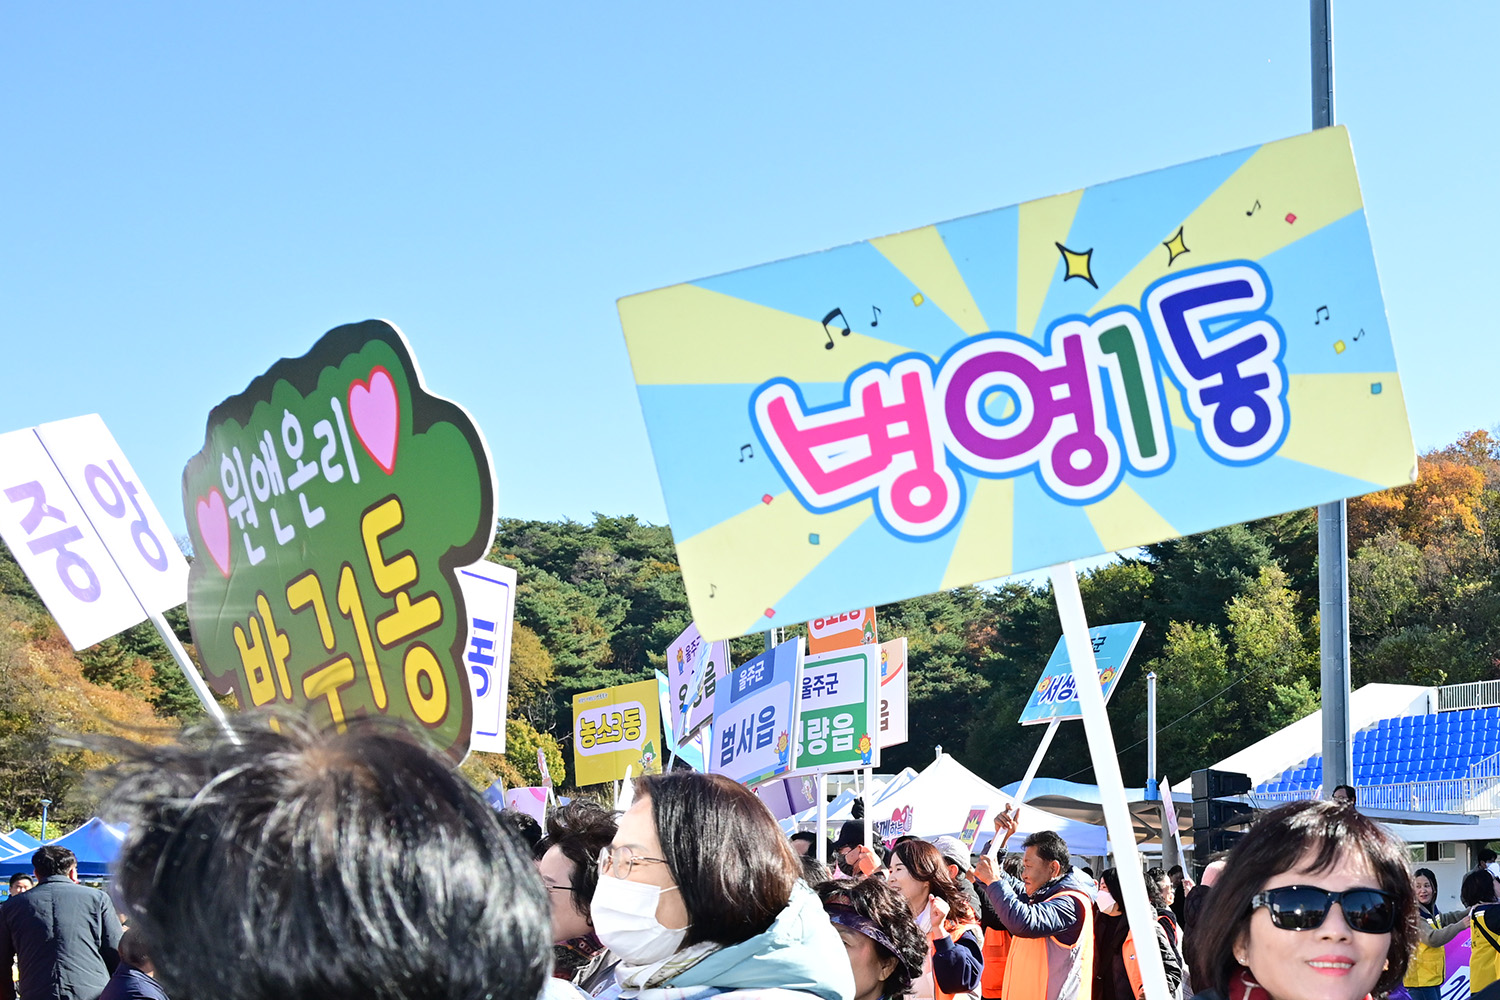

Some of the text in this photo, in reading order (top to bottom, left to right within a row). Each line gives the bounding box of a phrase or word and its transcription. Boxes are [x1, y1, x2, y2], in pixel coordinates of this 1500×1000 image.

[763, 276, 1275, 527] 병영1동
[219, 396, 361, 567] 원앤온리
[738, 660, 765, 692] 울주군
[801, 672, 839, 700] 울주군
[579, 707, 642, 750] 농소3동
[720, 705, 776, 768] 범서읍
